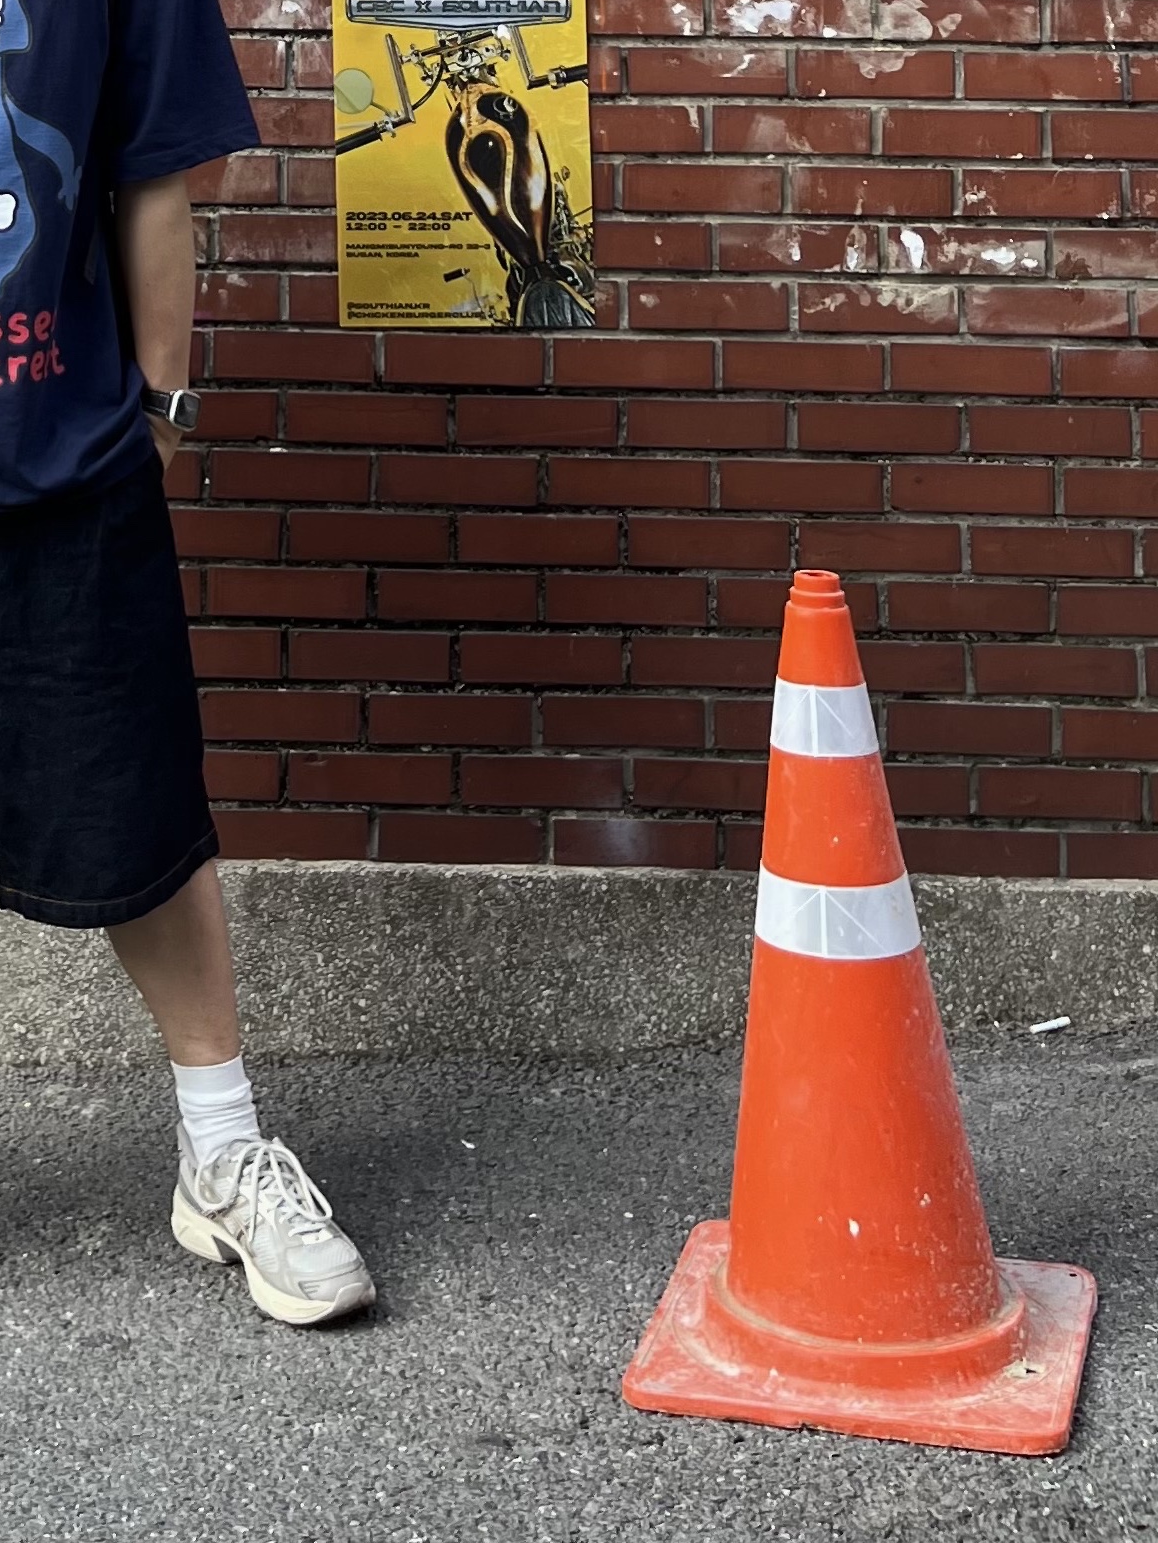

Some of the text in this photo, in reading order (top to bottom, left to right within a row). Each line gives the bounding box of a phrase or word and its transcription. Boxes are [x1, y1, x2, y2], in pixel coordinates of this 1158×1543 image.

[414, 0, 432, 13] X
[346, 211, 473, 221] 2023.06.24.SAT
[346, 222, 387, 231] 12:00
[408, 222, 451, 231] 22:00
